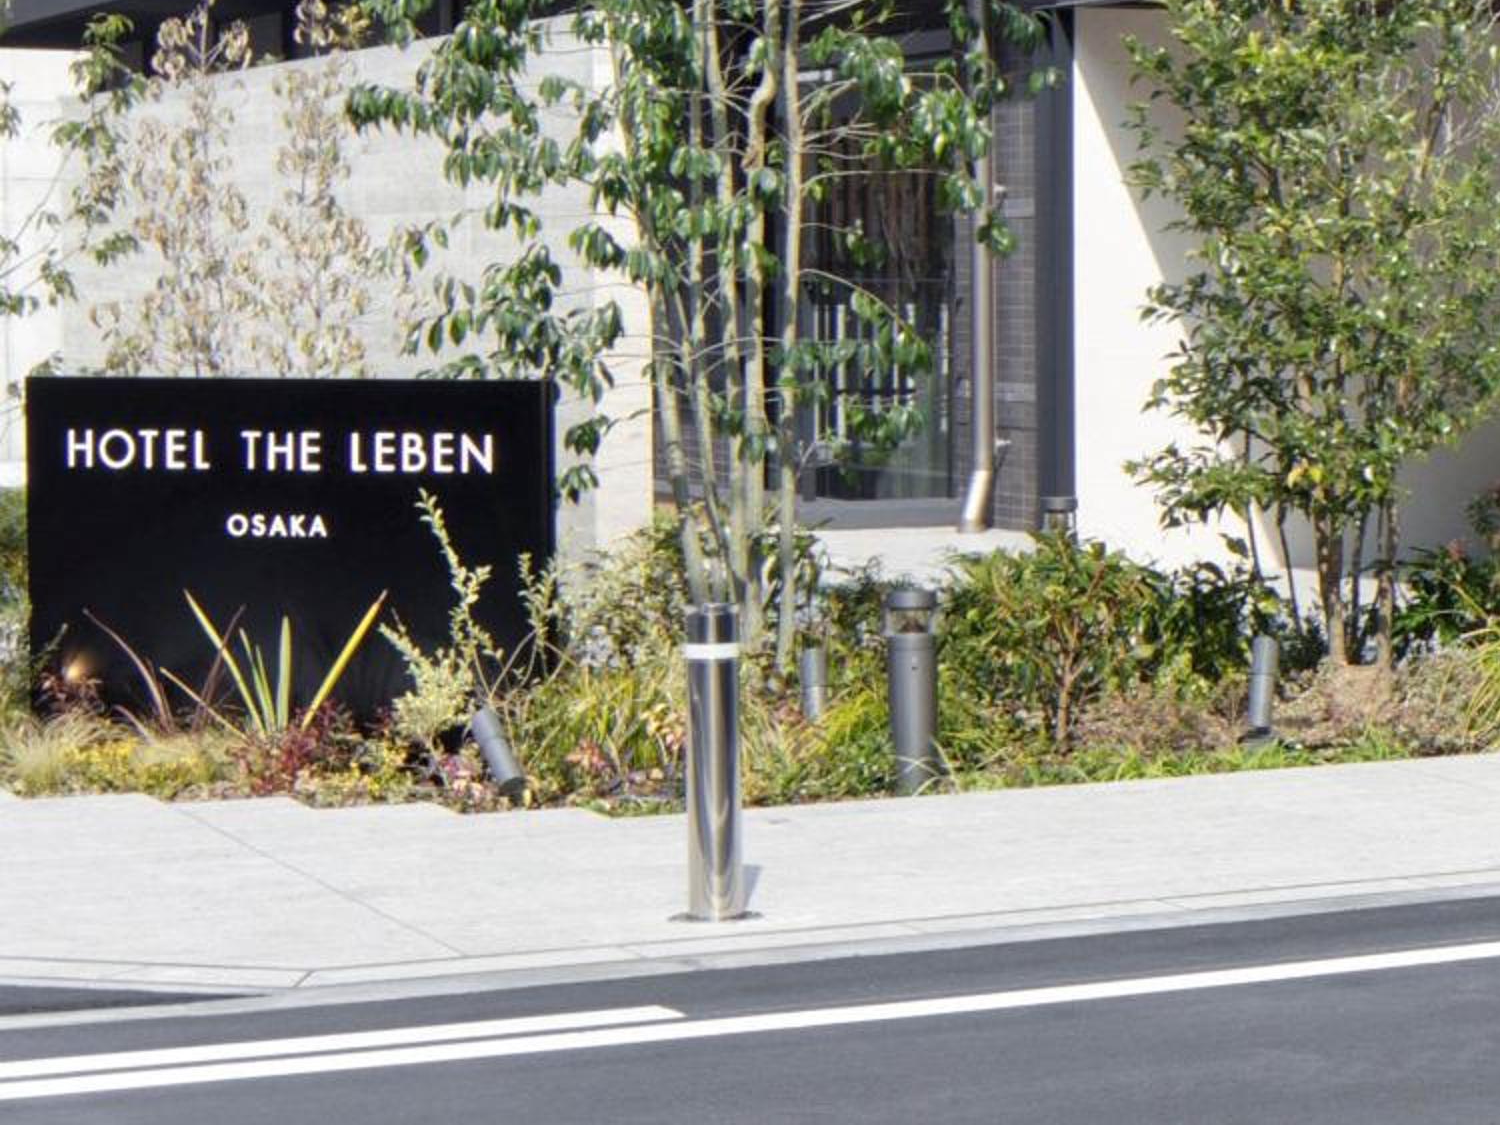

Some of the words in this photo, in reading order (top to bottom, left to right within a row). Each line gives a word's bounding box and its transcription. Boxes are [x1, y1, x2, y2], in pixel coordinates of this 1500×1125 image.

[66, 428, 211, 470] HOTEL
[241, 430, 321, 472] THE
[350, 431, 495, 474] LEBEN
[226, 513, 328, 538] OSAKA
